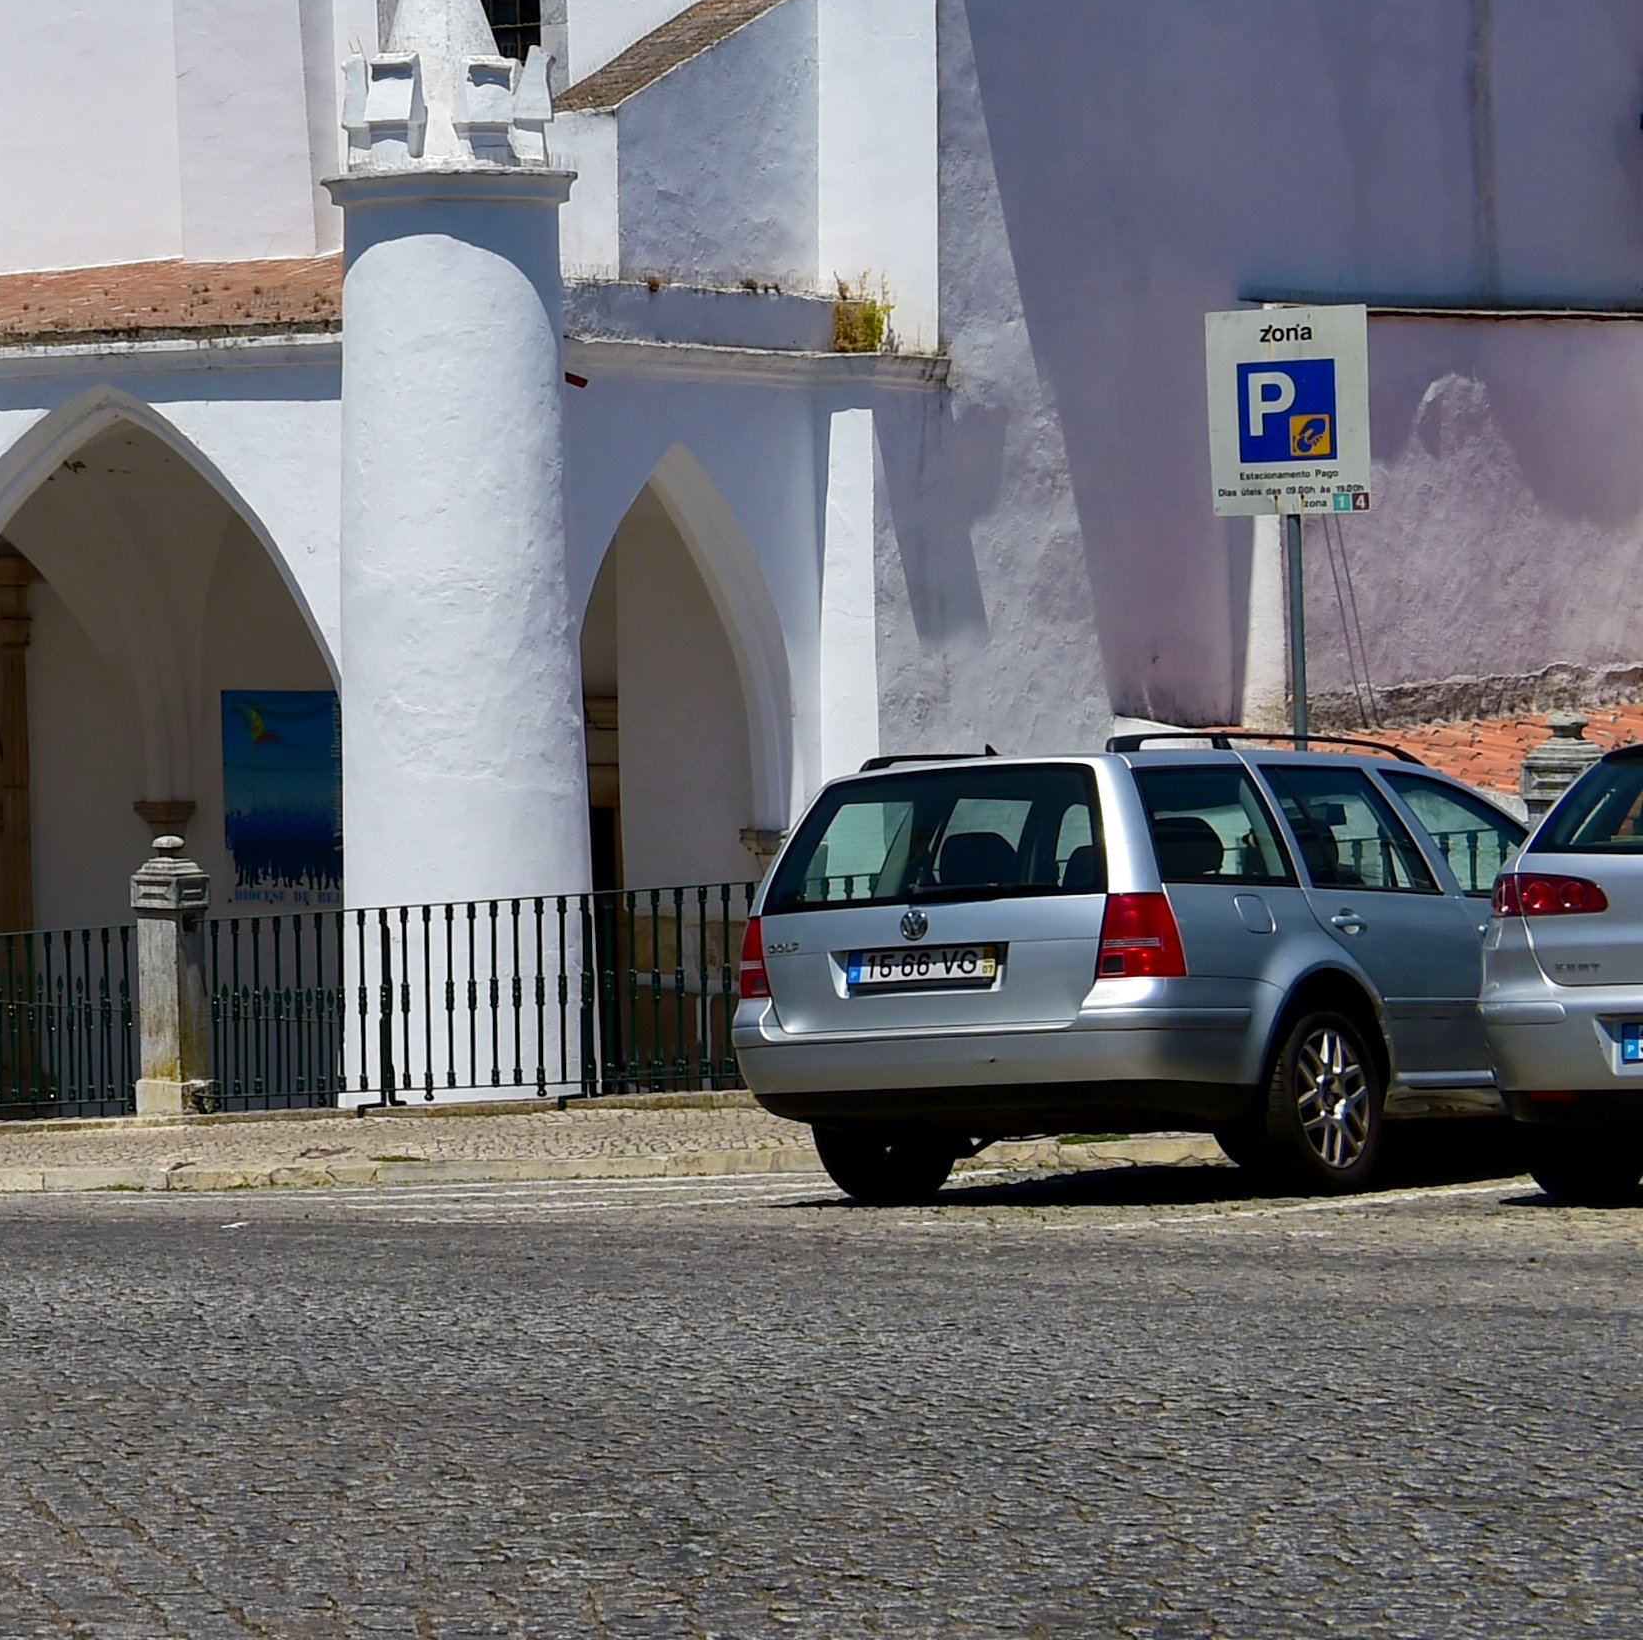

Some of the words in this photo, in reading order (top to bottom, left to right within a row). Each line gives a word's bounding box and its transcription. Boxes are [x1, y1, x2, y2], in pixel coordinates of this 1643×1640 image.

[1259, 325, 1312, 343] zona
[1248, 372, 1296, 437] P
[1239, 470, 1310, 481] Estacionamento
[1315, 468, 1339, 480] Pago
[1218, 488, 1237, 497] Dias
[1241, 486, 1261, 496] úteis
[1265, 486, 1282, 496] das
[1303, 499, 1327, 508] zona
[1337, 495, 1346, 508] 1
[1355, 495, 1366, 508] 4
[318, 891, 341, 904] BEJ
